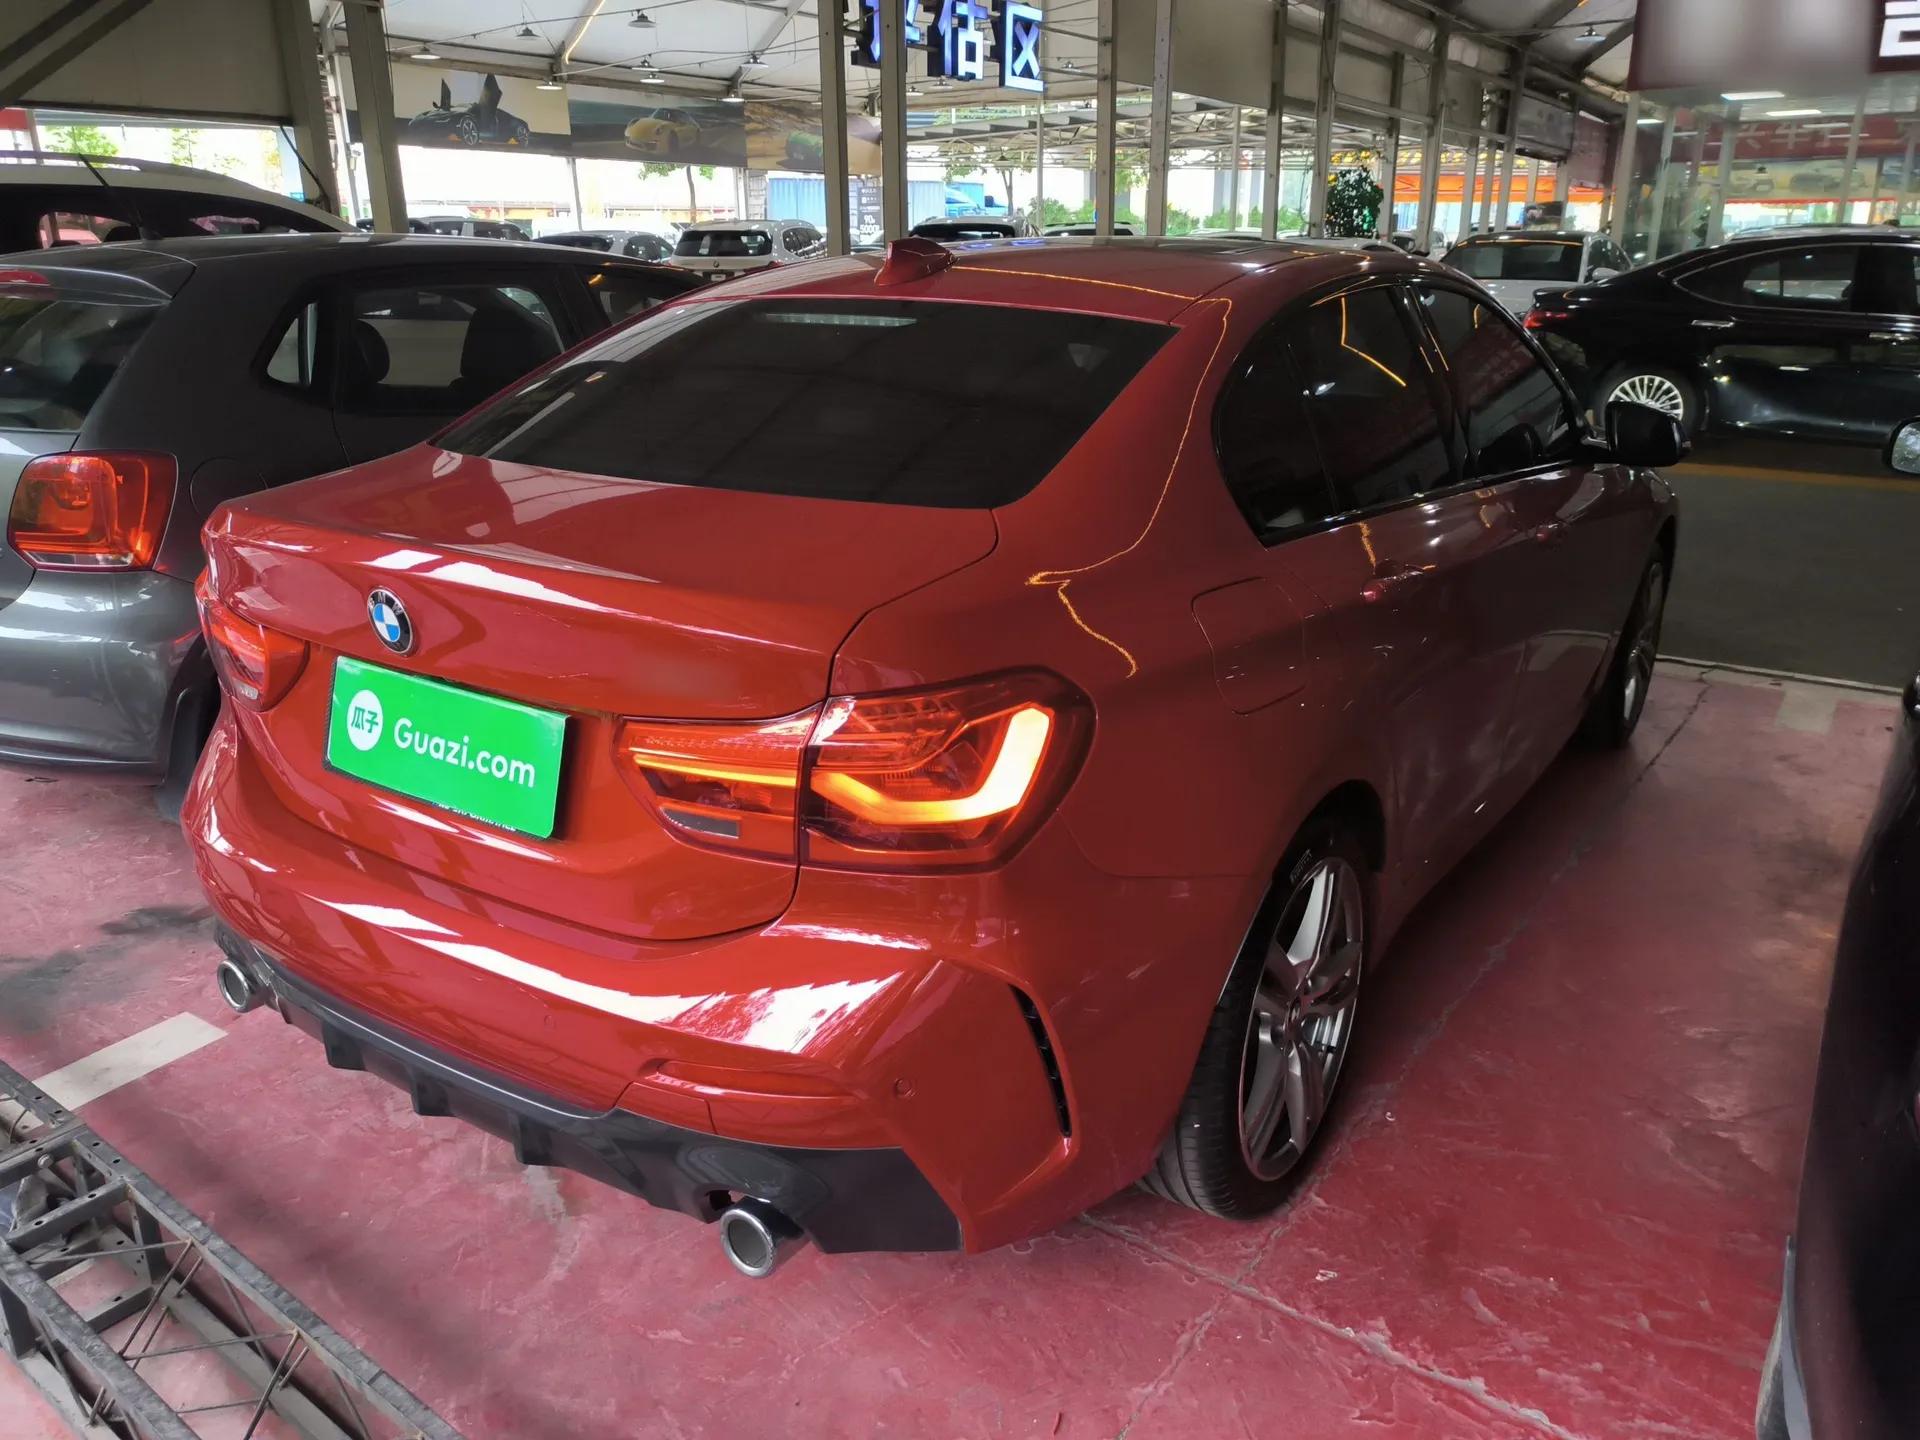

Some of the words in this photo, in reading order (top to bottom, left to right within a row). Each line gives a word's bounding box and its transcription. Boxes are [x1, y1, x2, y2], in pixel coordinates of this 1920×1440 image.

[368, 591, 404, 616] BMW
[350, 705, 379, 734] 瓜子
[393, 717, 536, 788] Guazi.com
